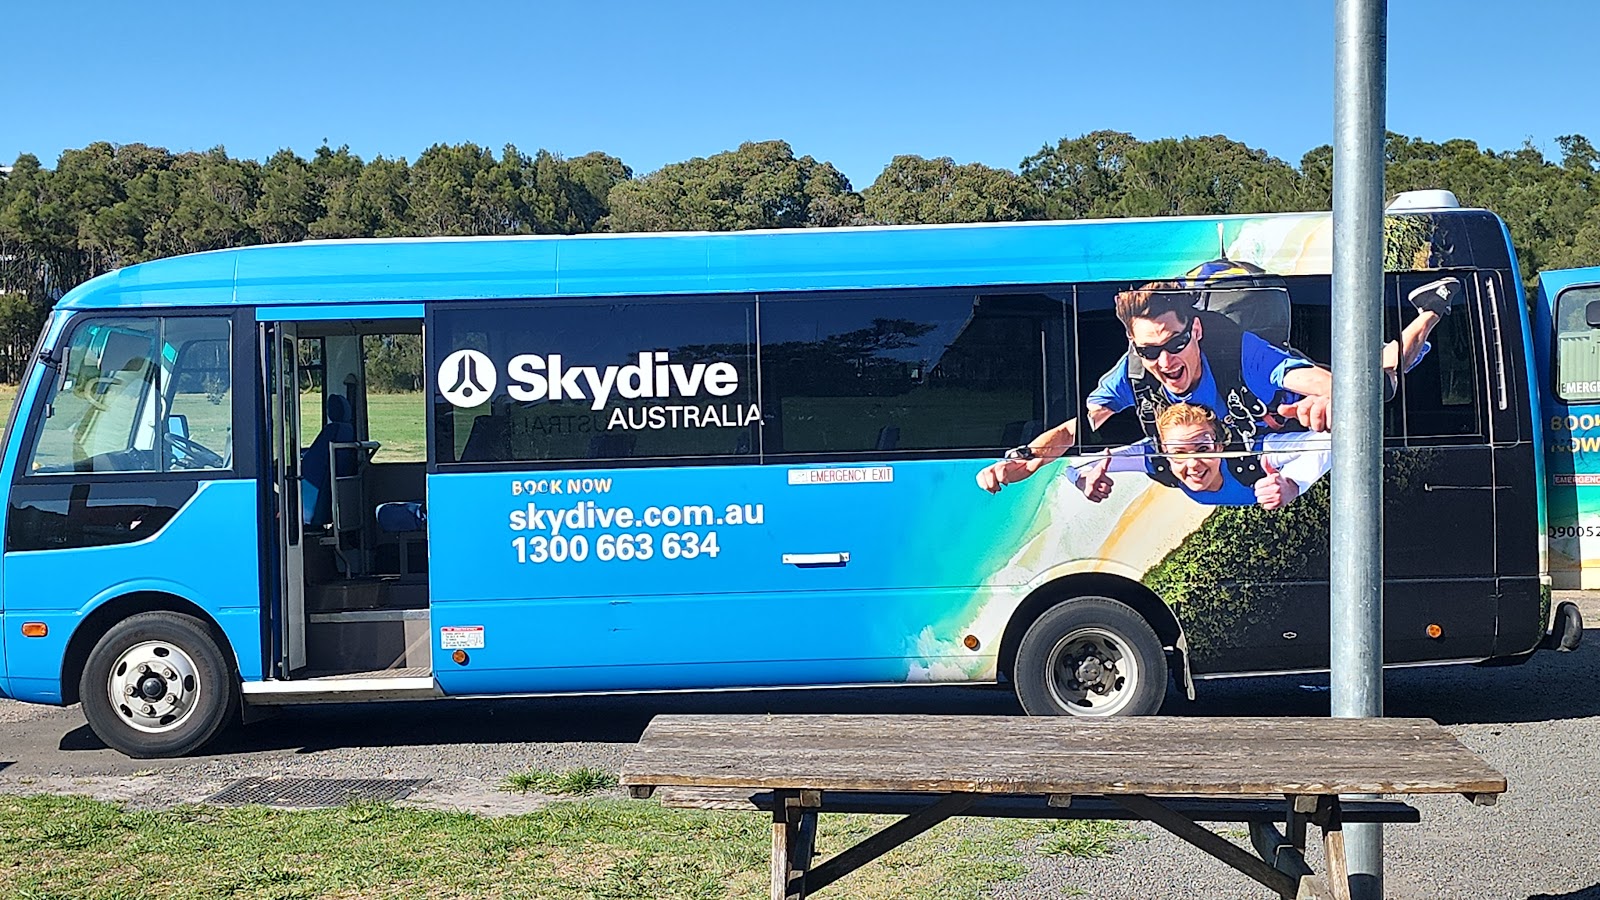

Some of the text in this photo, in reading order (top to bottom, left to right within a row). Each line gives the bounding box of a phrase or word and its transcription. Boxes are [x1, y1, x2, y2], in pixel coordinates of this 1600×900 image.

[507, 351, 739, 411] Skydive
[607, 403, 765, 430] AUSTRALIA
[511, 478, 612, 496] BOOK NOW
[810, 468, 892, 482] EMERGENCY EXIT
[509, 501, 765, 536] skydive.com.au
[511, 531, 720, 564] 1300 663 634
